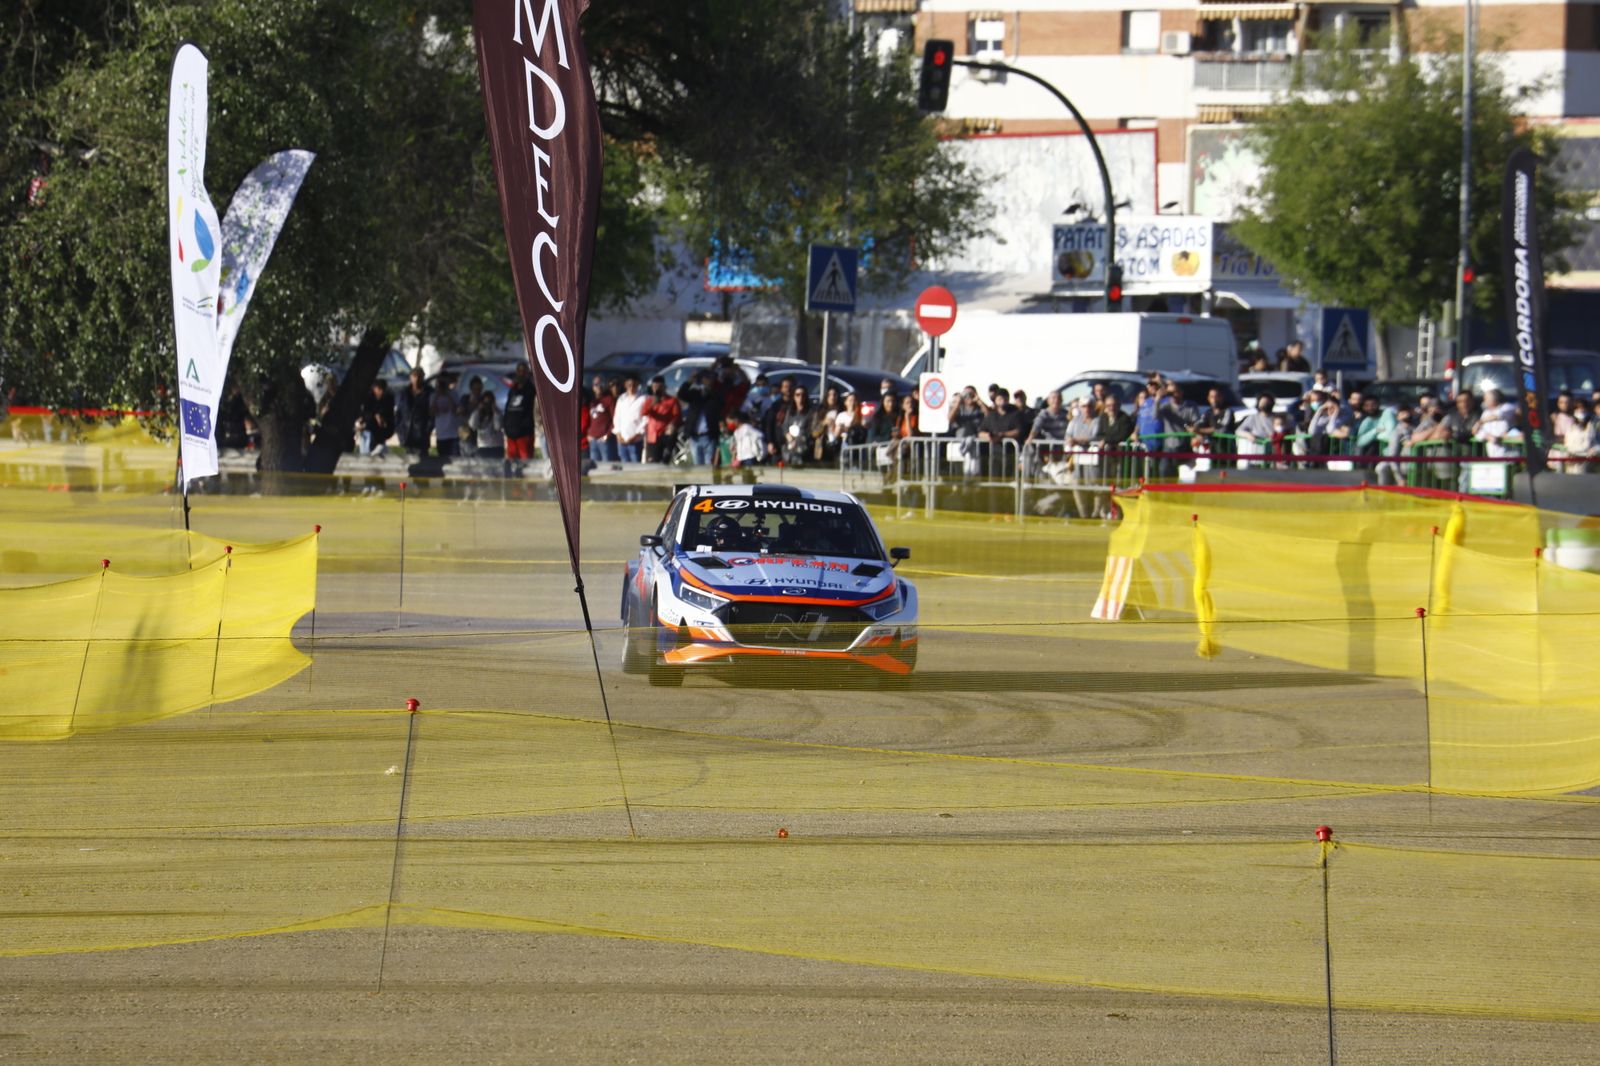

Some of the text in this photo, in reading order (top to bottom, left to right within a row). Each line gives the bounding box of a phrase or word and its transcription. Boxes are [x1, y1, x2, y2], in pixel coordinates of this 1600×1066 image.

[1054, 225, 1207, 250] PATATS ASADAS
[692, 498, 843, 515] 4 HYUNDAI
[774, 577, 843, 589] HYUNDAI
